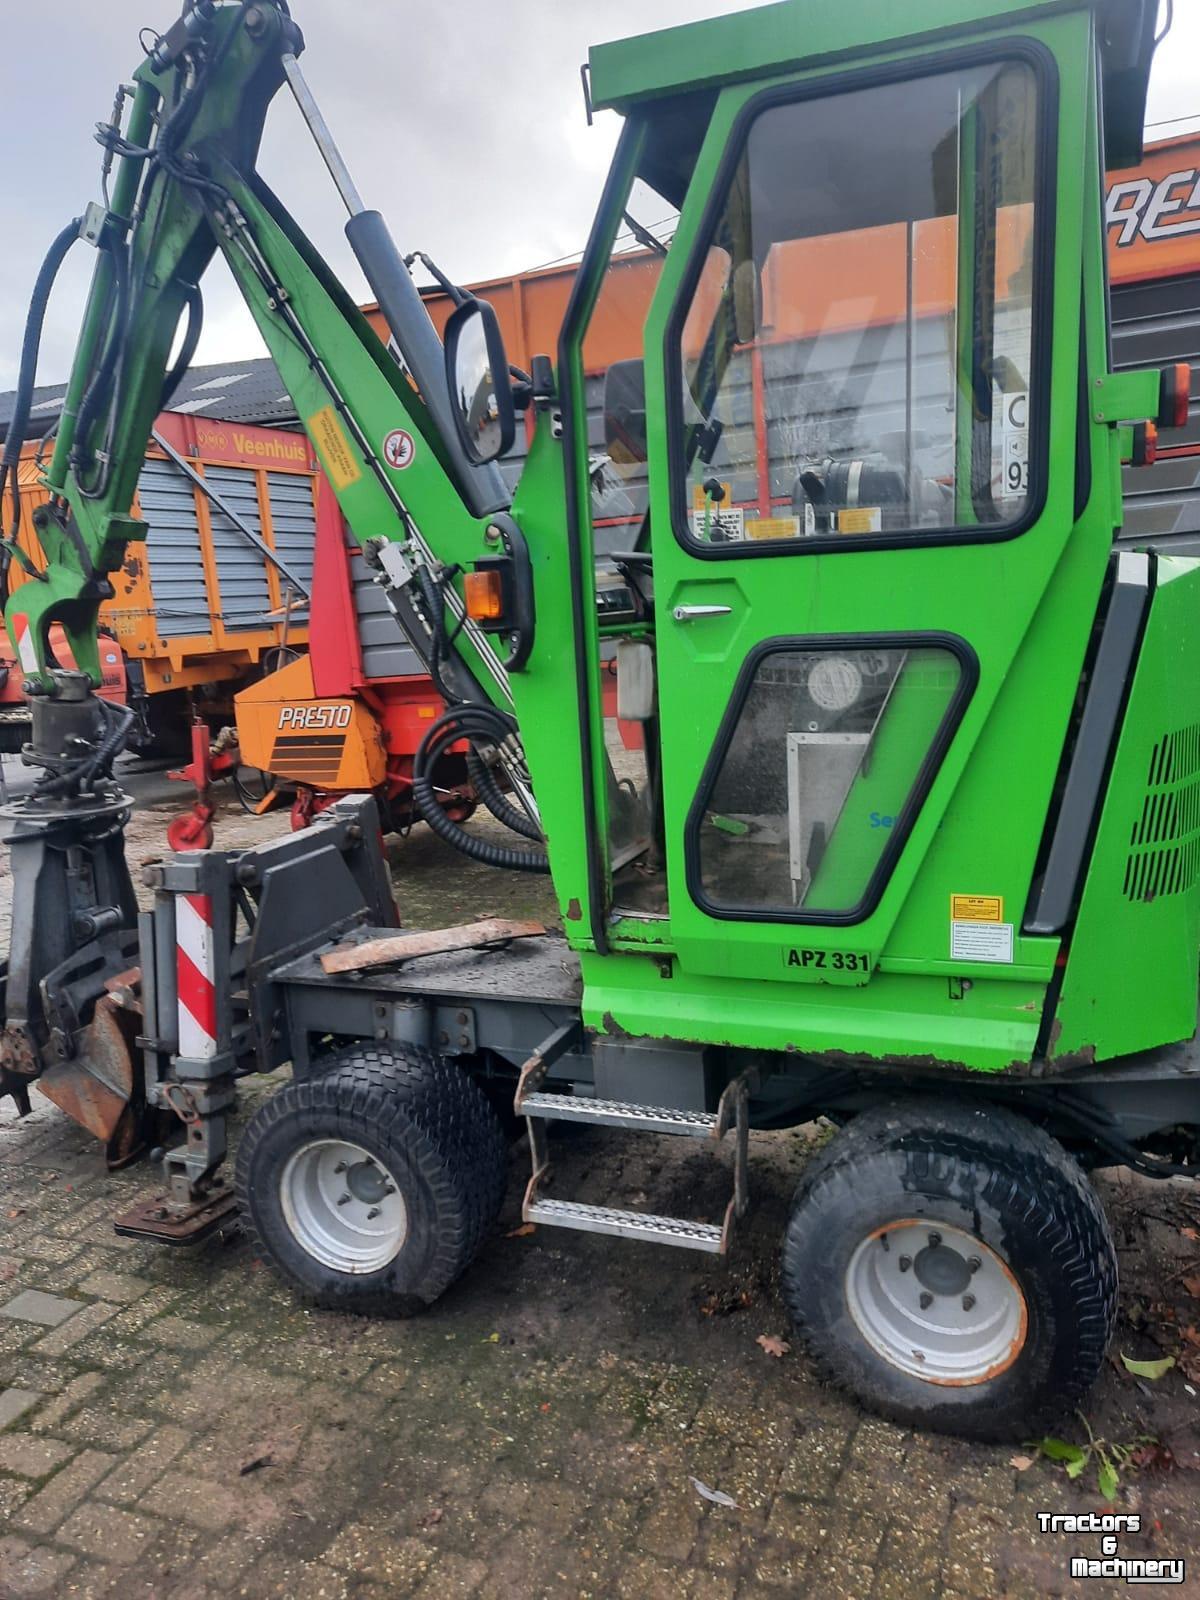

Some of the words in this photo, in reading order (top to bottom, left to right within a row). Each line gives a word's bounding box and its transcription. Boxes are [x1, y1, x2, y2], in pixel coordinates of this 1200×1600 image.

[232, 433, 307, 461] Veenhuis
[278, 704, 351, 729] PRESTO
[788, 949, 827, 968] APZ
[832, 952, 868, 971] 331
